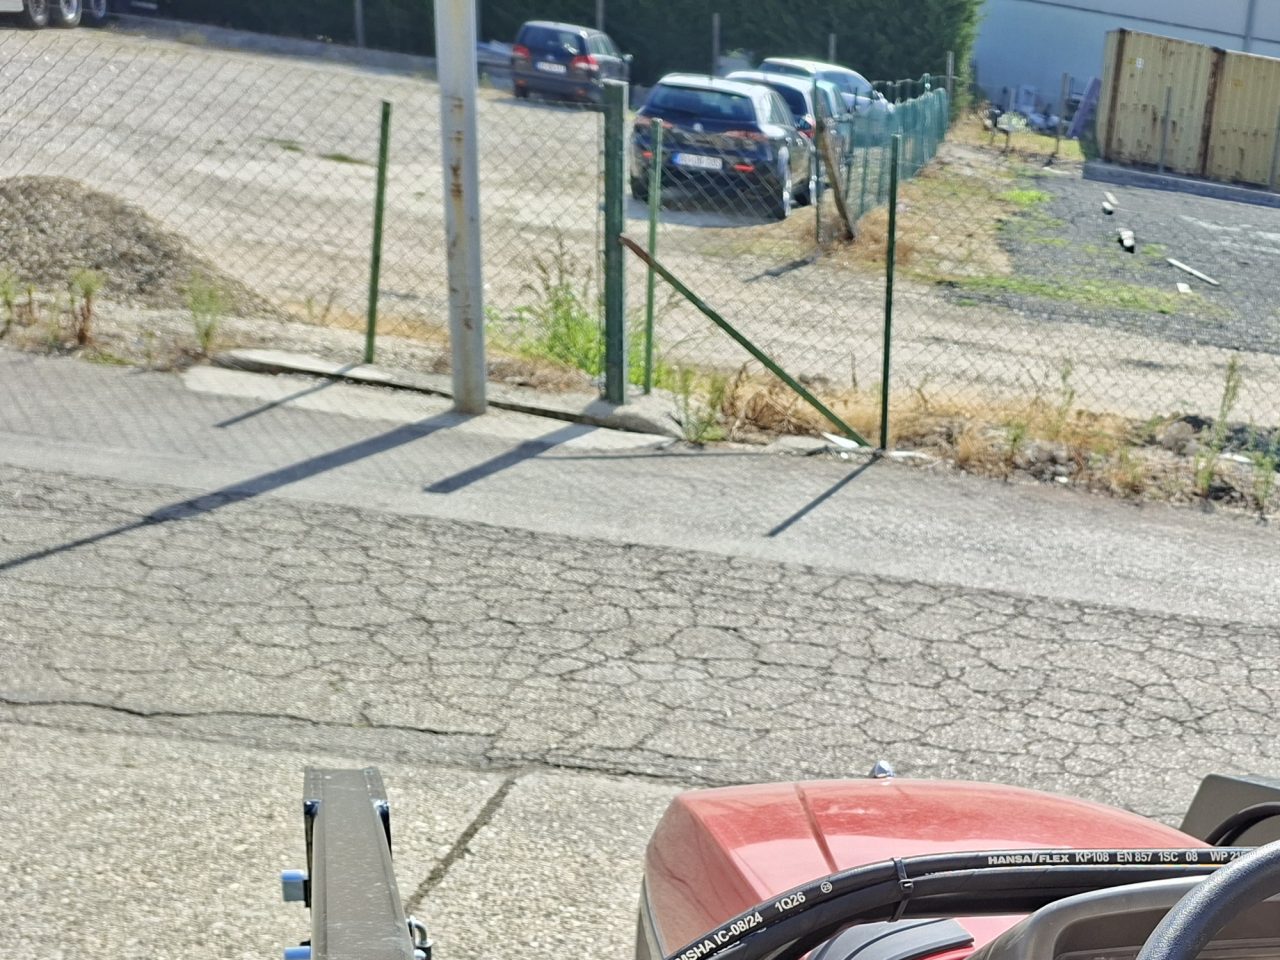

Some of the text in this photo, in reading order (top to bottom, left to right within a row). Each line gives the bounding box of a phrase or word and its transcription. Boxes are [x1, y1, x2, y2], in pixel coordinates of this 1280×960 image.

[1075, 851, 1109, 863] KP108
[1117, 851, 1133, 862] EN
[1135, 851, 1152, 863] 857
[1158, 851, 1178, 862] 1SC
[1186, 851, 1198, 862] 08
[1210, 850, 1228, 862] WP
[714, 911, 763, 945] IC-08/24
[774, 892, 806, 913] 1Q26
